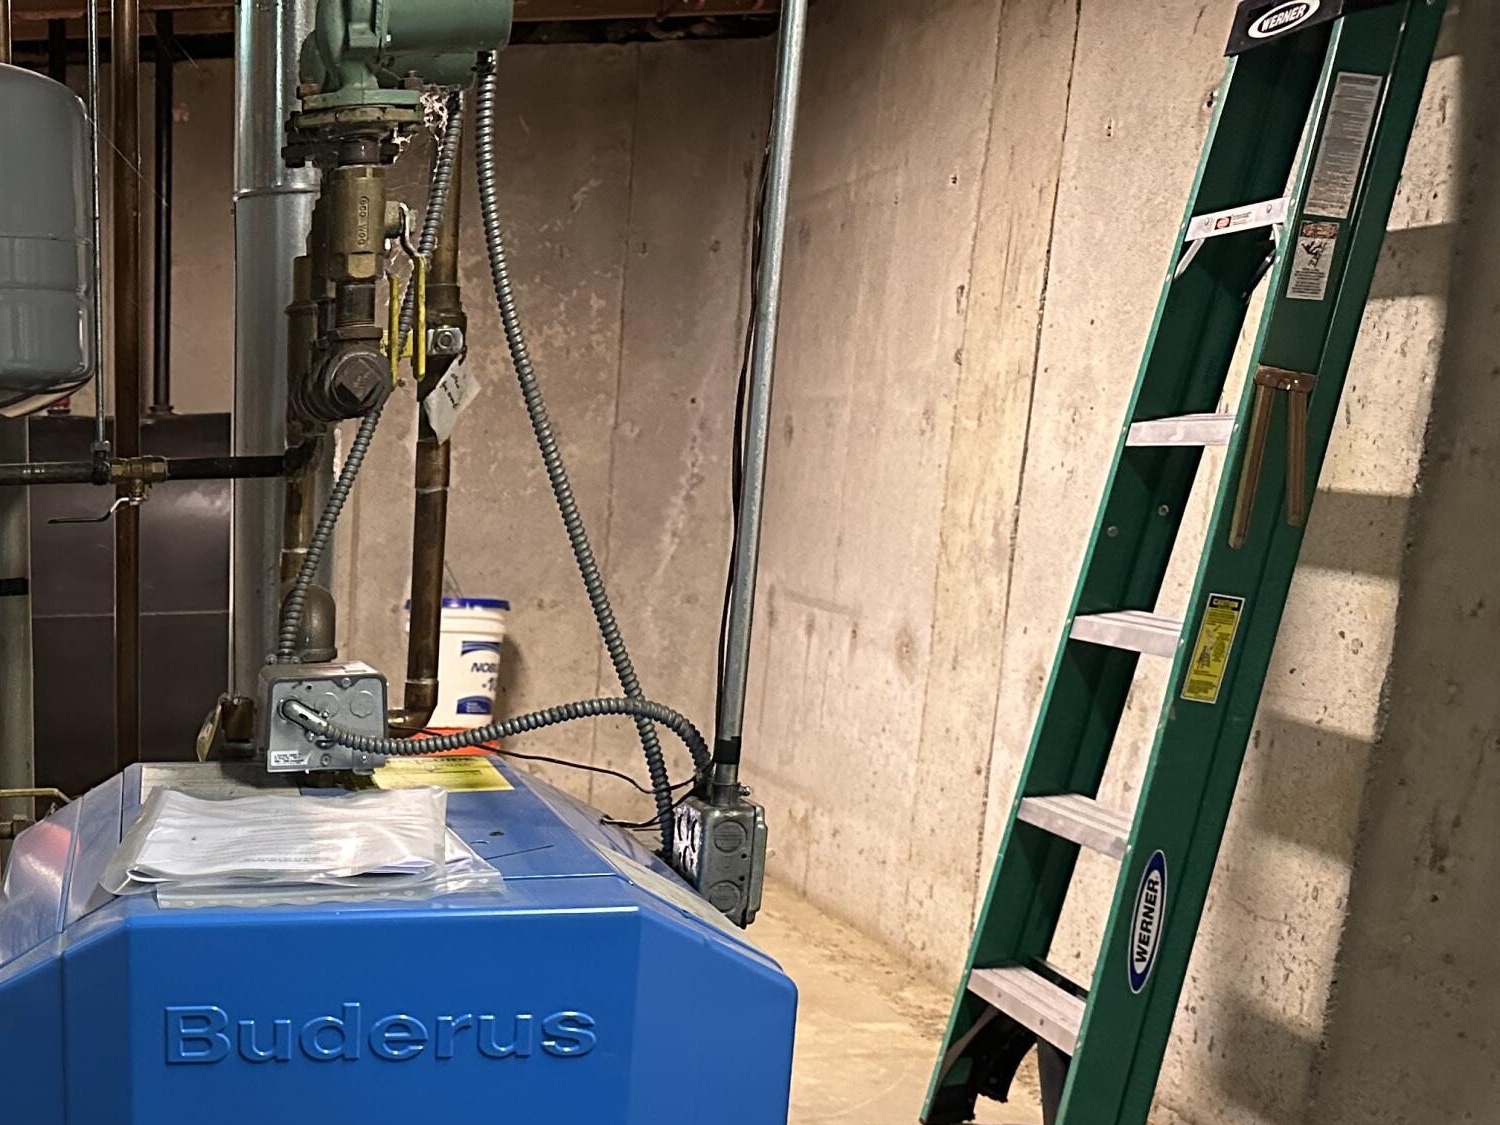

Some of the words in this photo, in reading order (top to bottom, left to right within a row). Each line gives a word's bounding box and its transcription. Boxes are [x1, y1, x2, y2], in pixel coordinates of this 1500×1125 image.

[1261, 4, 1307, 32] WERNER
[1135, 878, 1160, 963] WERNER
[164, 1001, 597, 1065] Buderus
